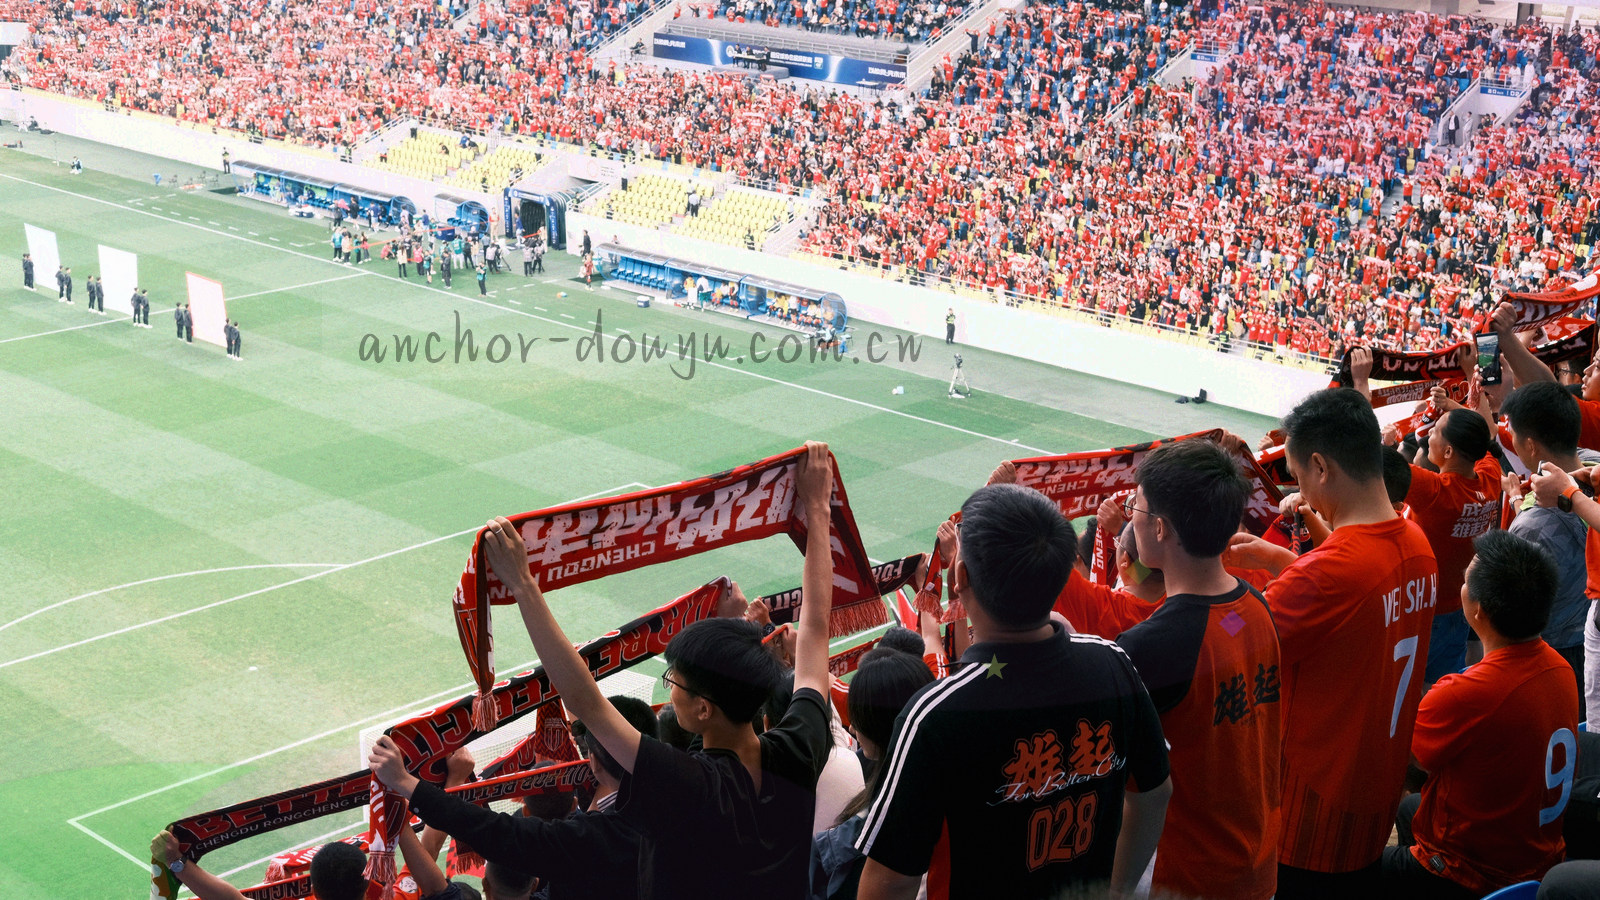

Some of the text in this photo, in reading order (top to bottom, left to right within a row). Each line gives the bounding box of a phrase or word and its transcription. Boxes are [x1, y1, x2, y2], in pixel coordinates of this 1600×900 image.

[547, 539, 656, 583] CHENGDU
[1390, 635, 1418, 738] 7
[1002, 718, 1115, 802] 雄起
[1539, 728, 1577, 827] 9
[178, 774, 372, 841] BETTE
[195, 823, 259, 851] CHENGDU
[263, 798, 351, 828] RONGCHENG
[1026, 790, 1099, 873] 028
